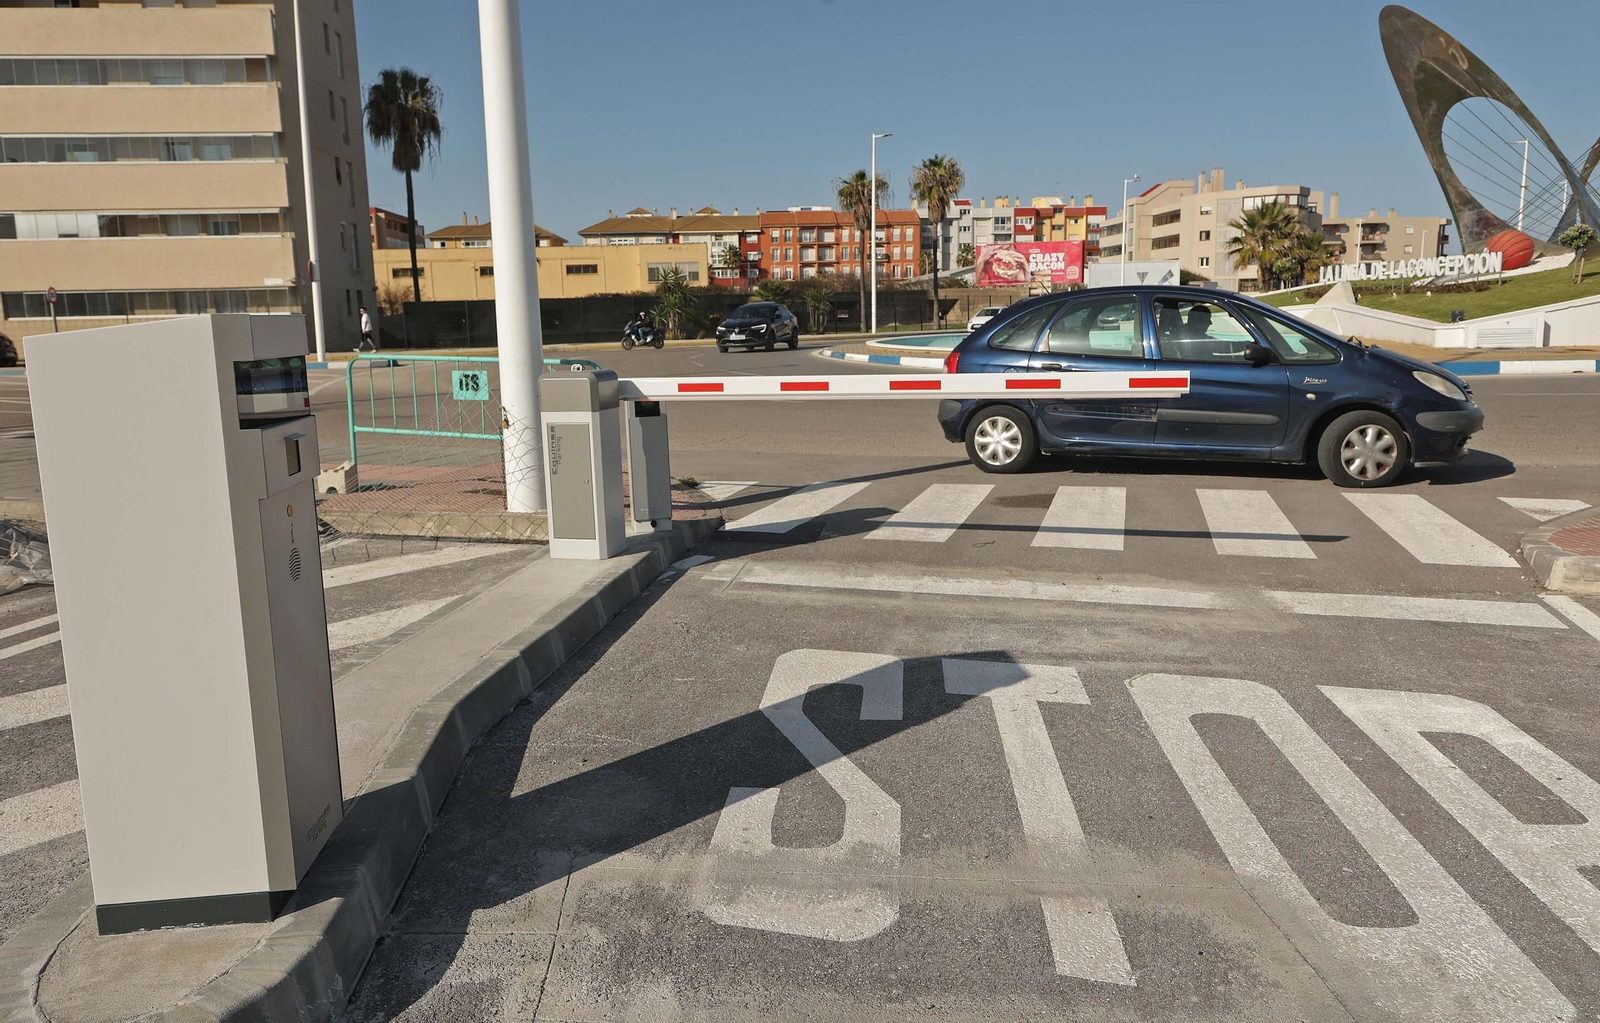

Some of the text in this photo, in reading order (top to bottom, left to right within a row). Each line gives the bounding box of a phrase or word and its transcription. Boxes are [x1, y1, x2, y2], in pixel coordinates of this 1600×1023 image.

[1029, 253, 1065, 262] CRAZY
[1029, 262, 1065, 271] BACON
[1319, 265, 1334, 282] LA
[1371, 262, 1388, 280] DE
[1390, 260, 1407, 279] LA
[1407, 247, 1502, 278] CONCEPCIÓN
[698, 648, 1600, 1023] STOP
